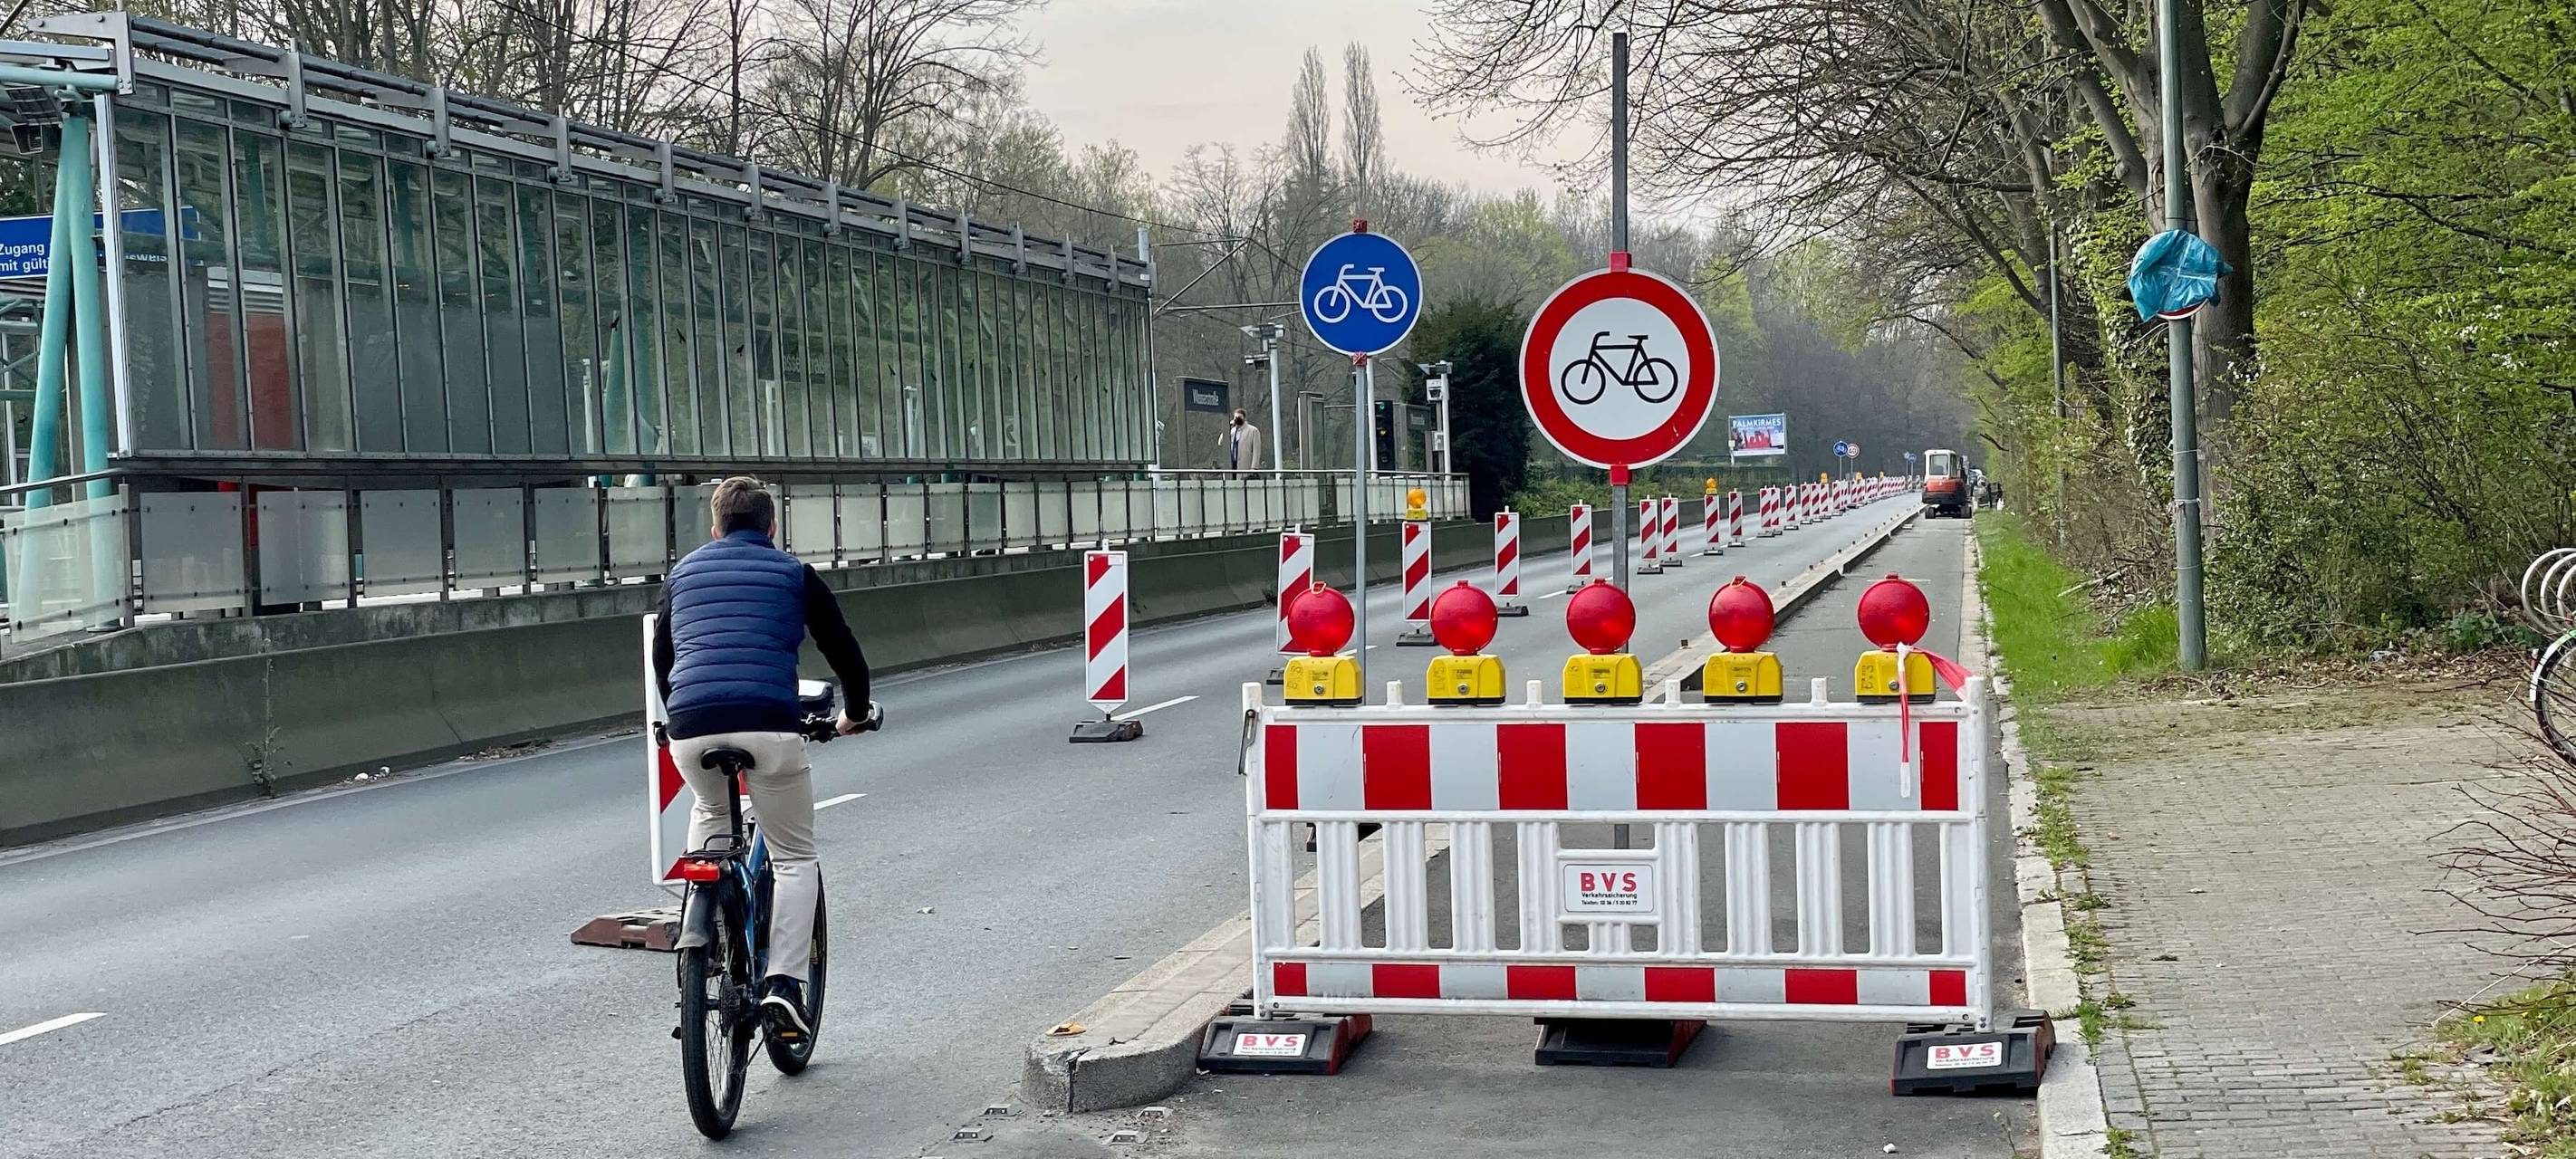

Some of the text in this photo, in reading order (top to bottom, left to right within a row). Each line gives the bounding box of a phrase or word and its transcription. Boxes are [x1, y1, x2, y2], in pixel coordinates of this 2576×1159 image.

[0, 244, 45, 258] Zugang
[0, 257, 51, 273] mit gülti
[1581, 872, 1637, 892] BVS
[1243, 1035, 1298, 1047] BVS
[1935, 1044, 1994, 1058] BVS
